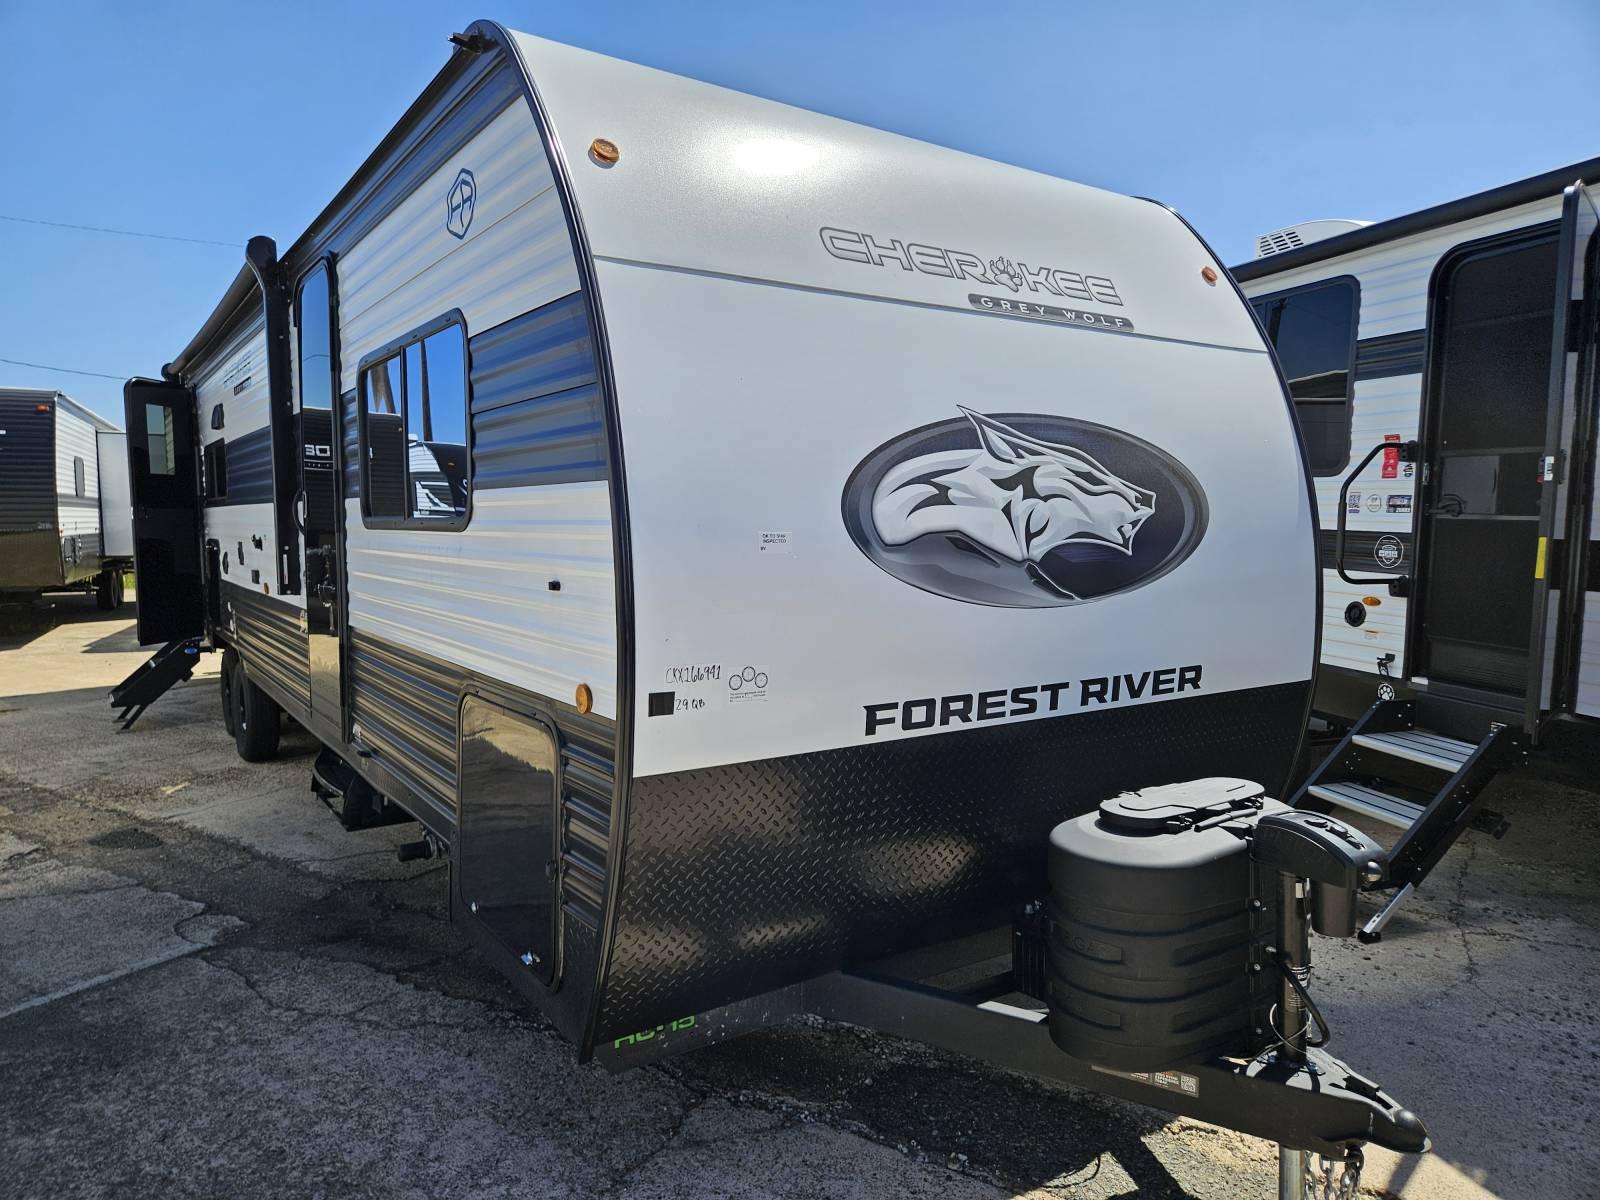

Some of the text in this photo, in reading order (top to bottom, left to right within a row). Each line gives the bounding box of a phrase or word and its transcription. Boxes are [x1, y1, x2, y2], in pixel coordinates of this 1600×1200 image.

[819, 226, 1123, 306] CHEROKEE
[980, 297, 1126, 328] GREY WOLF
[863, 664, 1203, 736] FOREST RIVER
